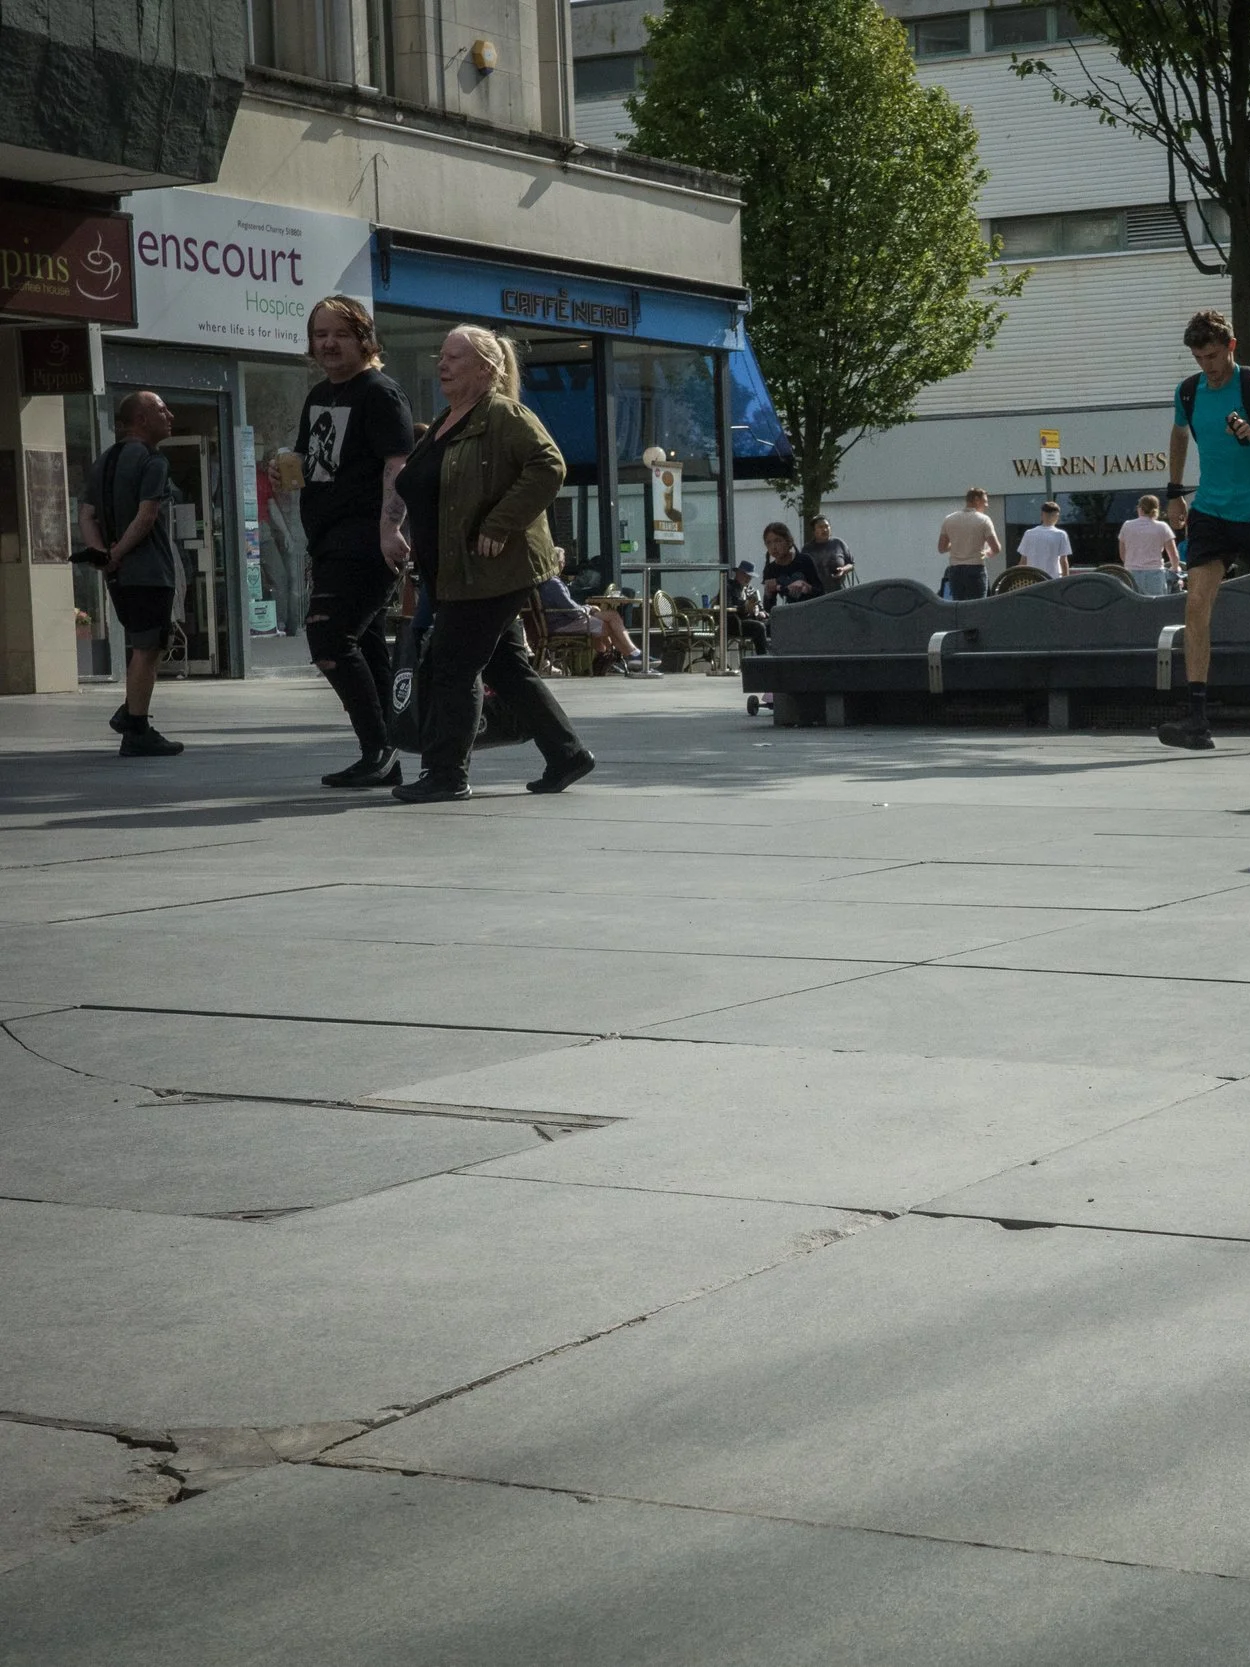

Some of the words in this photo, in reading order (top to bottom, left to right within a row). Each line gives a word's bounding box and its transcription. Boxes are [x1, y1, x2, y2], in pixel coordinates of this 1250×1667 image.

[237, 220, 265, 231] Registered
[265, 225, 285, 237] Charity
[137, 230, 304, 286] enscourt
[246, 290, 305, 320] Hospice
[571, 298, 629, 329] NERO
[198, 321, 227, 334] where
[230, 323, 244, 336] life
[248, 326, 256, 337] is
[258, 327, 272, 338] for
[31, 367, 85, 391] Pippins
[1102, 452, 1167, 476] JAMES
